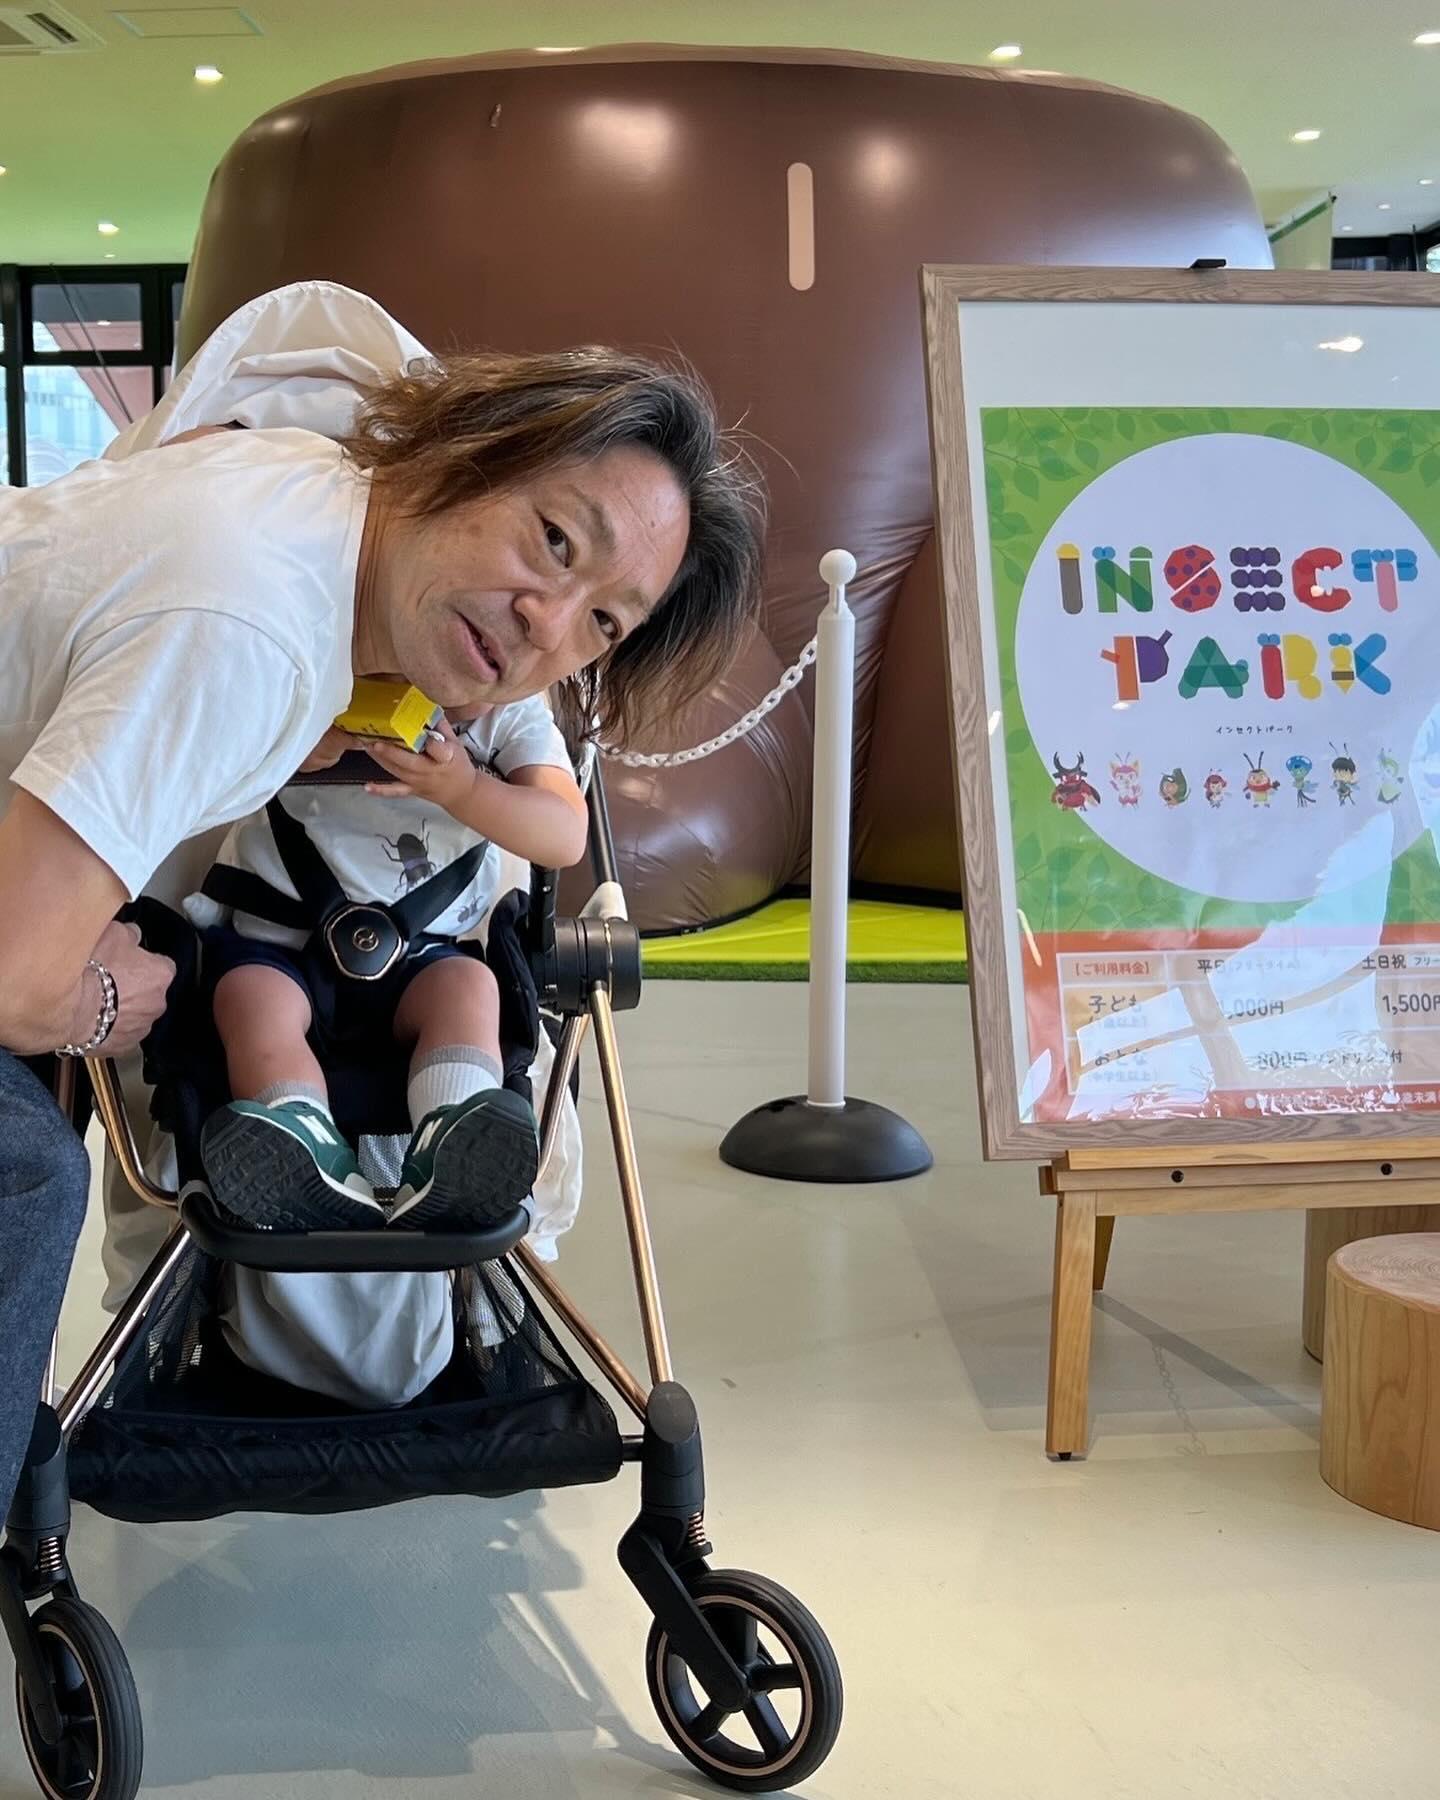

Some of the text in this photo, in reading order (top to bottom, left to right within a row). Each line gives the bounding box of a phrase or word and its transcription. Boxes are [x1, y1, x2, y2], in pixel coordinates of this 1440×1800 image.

[1055, 543, 1418, 615] INSECT
[1101, 630, 1392, 700] PARK
[1216, 724, 1293, 735] インセクトパーク
[1362, 954, 1406, 970] 土日祝
